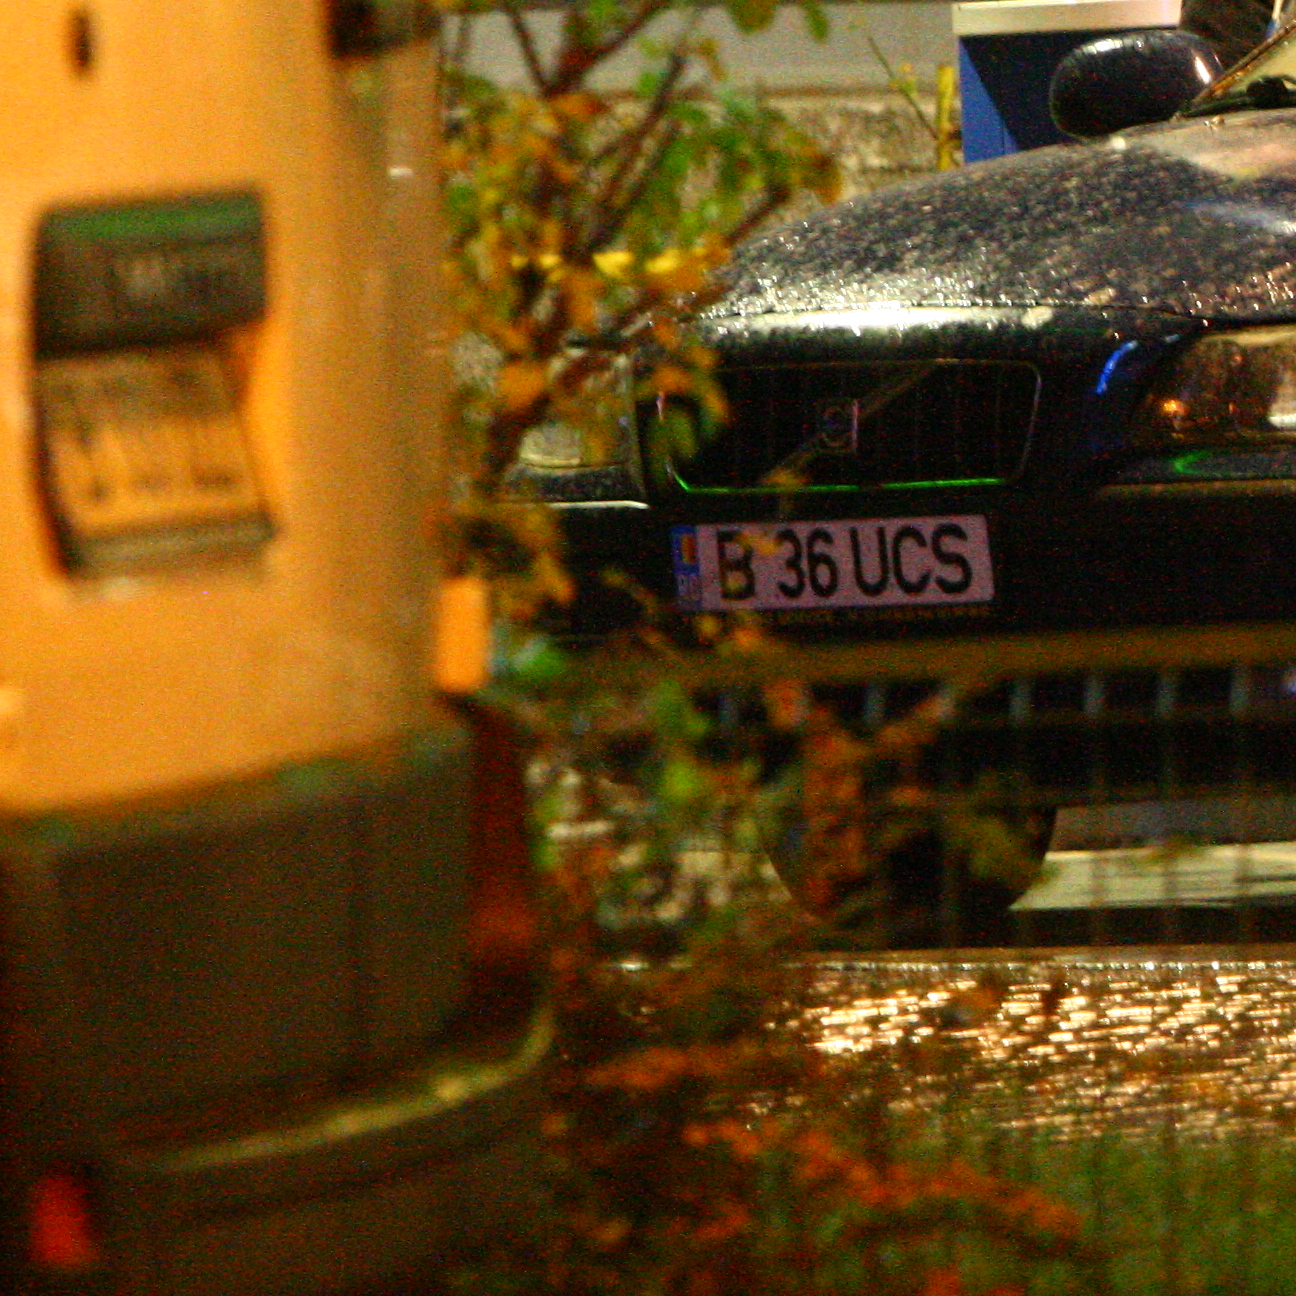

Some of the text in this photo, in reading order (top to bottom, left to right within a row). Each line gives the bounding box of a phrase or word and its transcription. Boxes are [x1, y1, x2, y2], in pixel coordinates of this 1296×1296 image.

[715, 522, 973, 601] B 36 UCS
